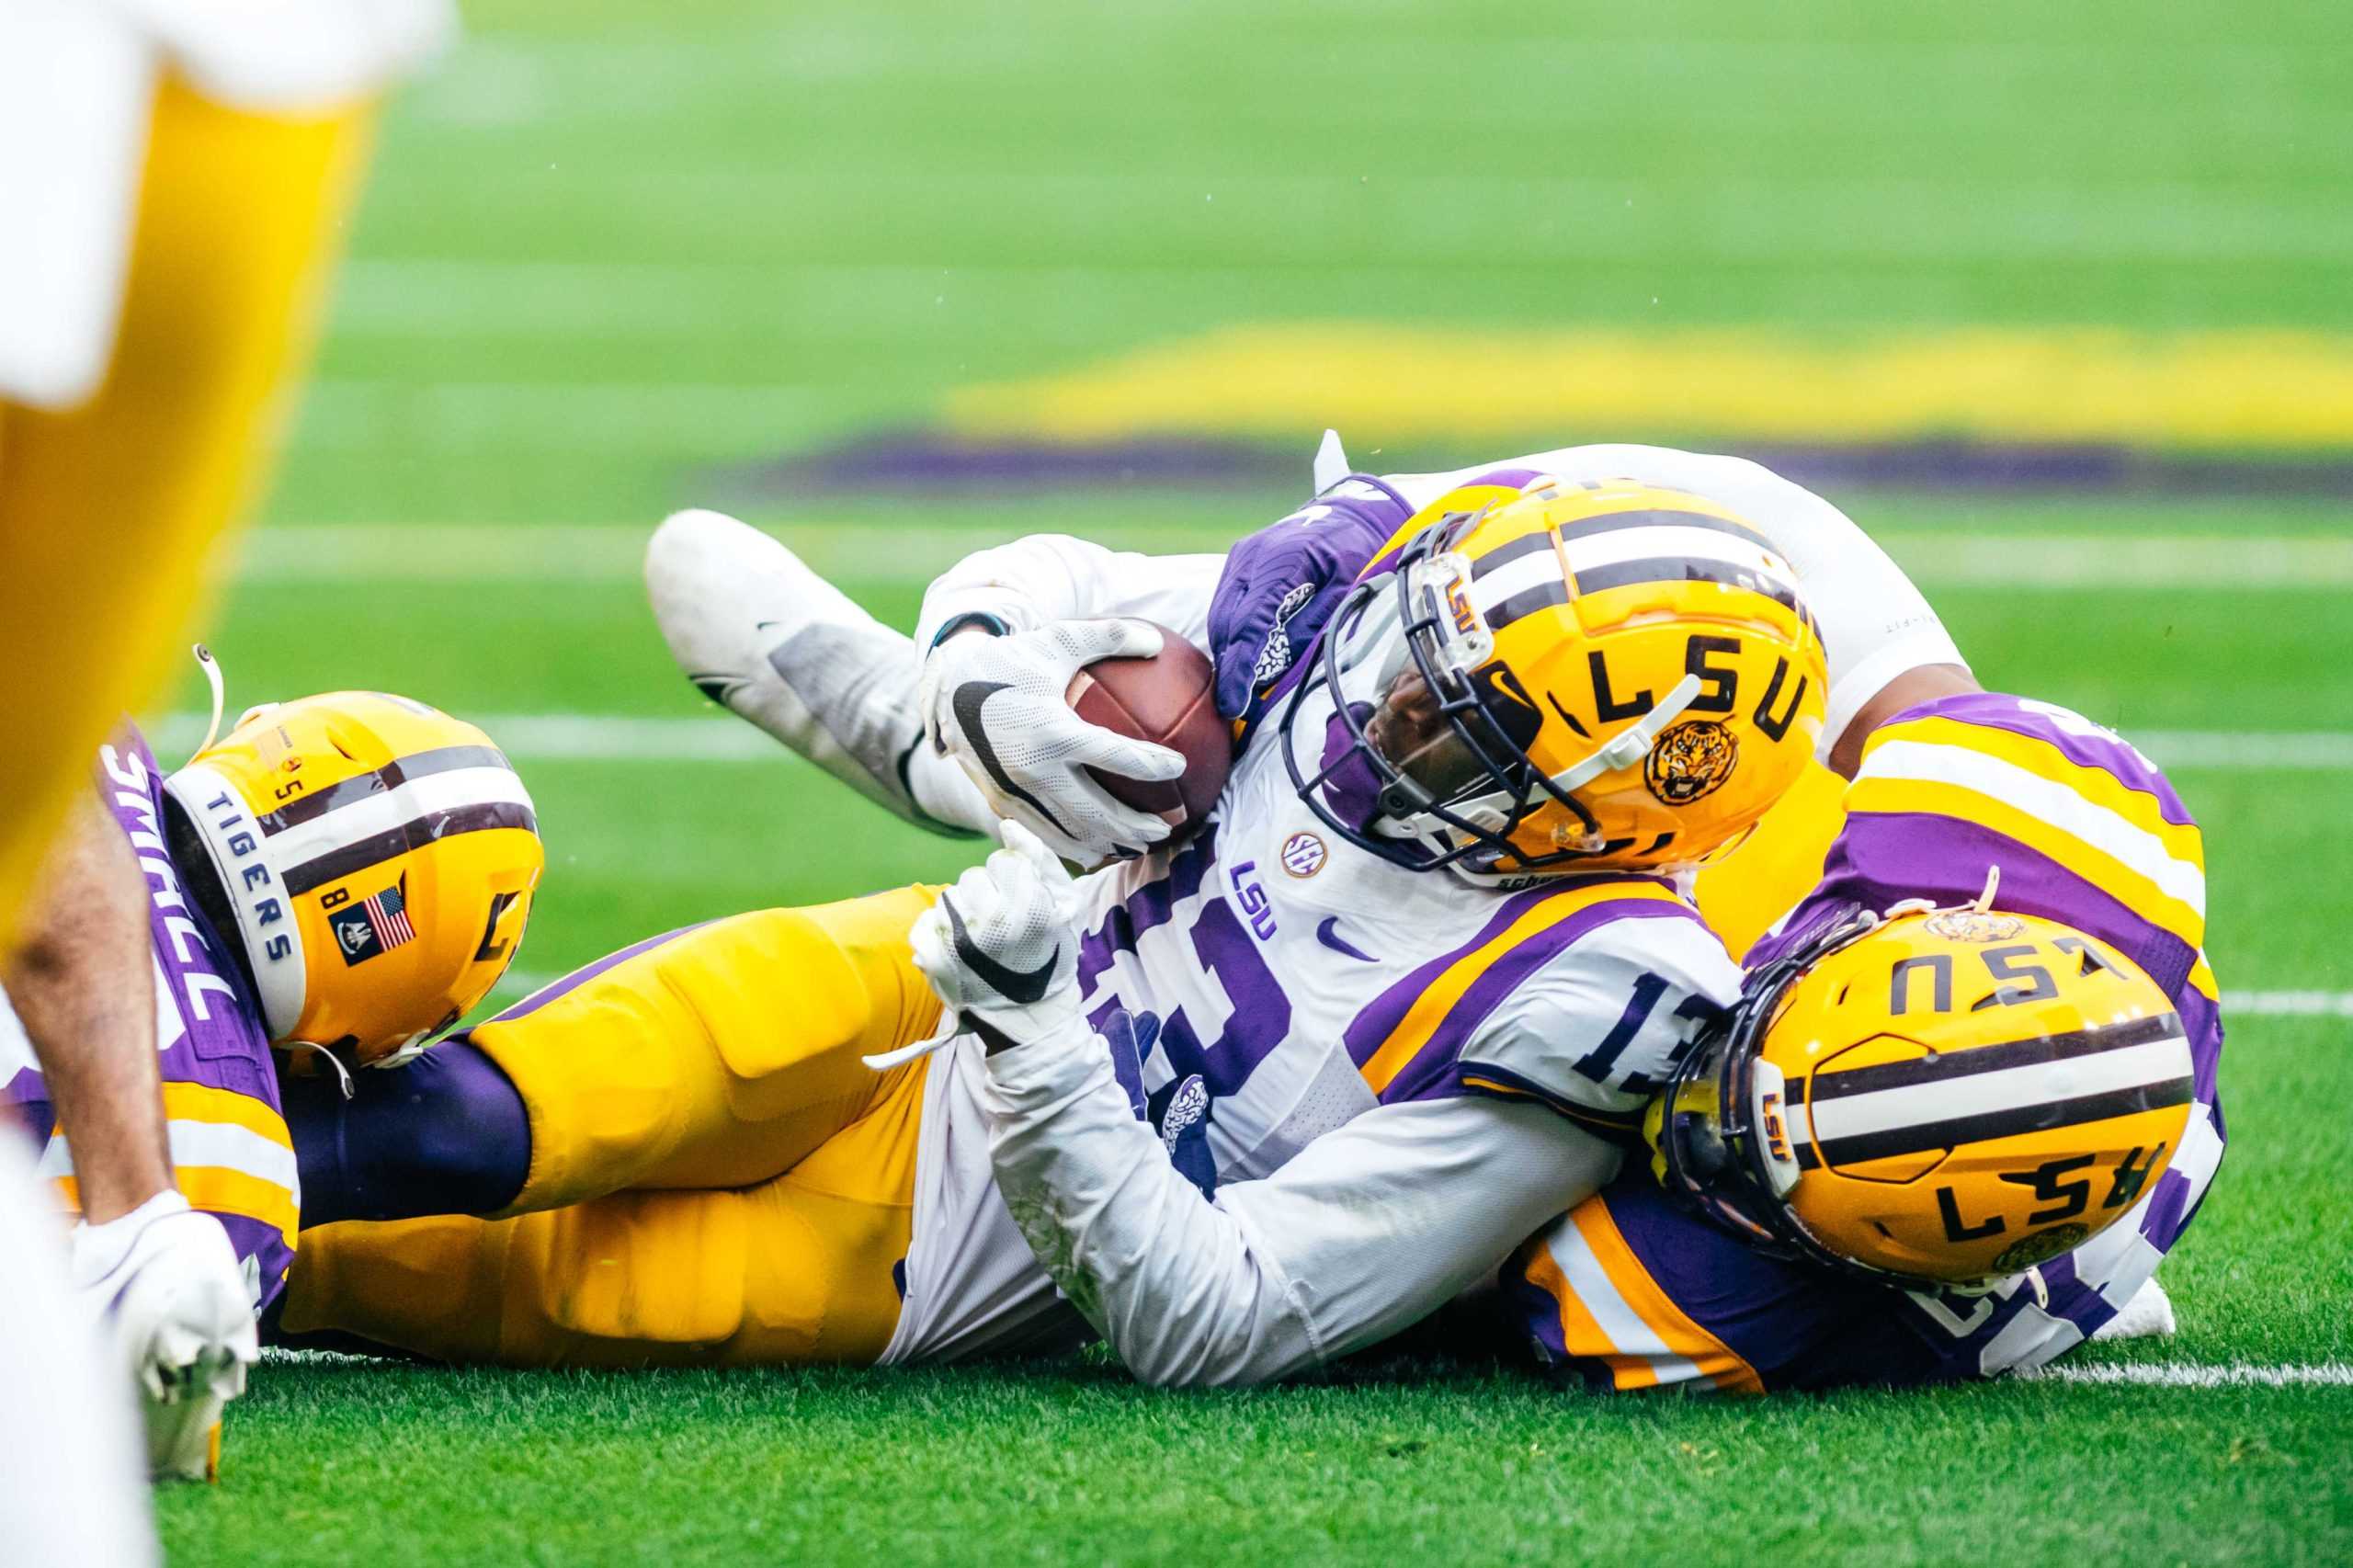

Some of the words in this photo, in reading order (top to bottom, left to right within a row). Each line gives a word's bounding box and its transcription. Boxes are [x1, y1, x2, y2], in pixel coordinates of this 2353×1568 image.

[1444, 574, 1479, 636] LSU
[1587, 634, 1808, 743] LSU
[275, 780, 303, 801] 5
[207, 790, 292, 962] TIGERS
[1283, 833, 1325, 876] SEC
[320, 888, 350, 910] 8
[1230, 860, 1278, 941] LSU
[1763, 1092, 1791, 1162] LSU
